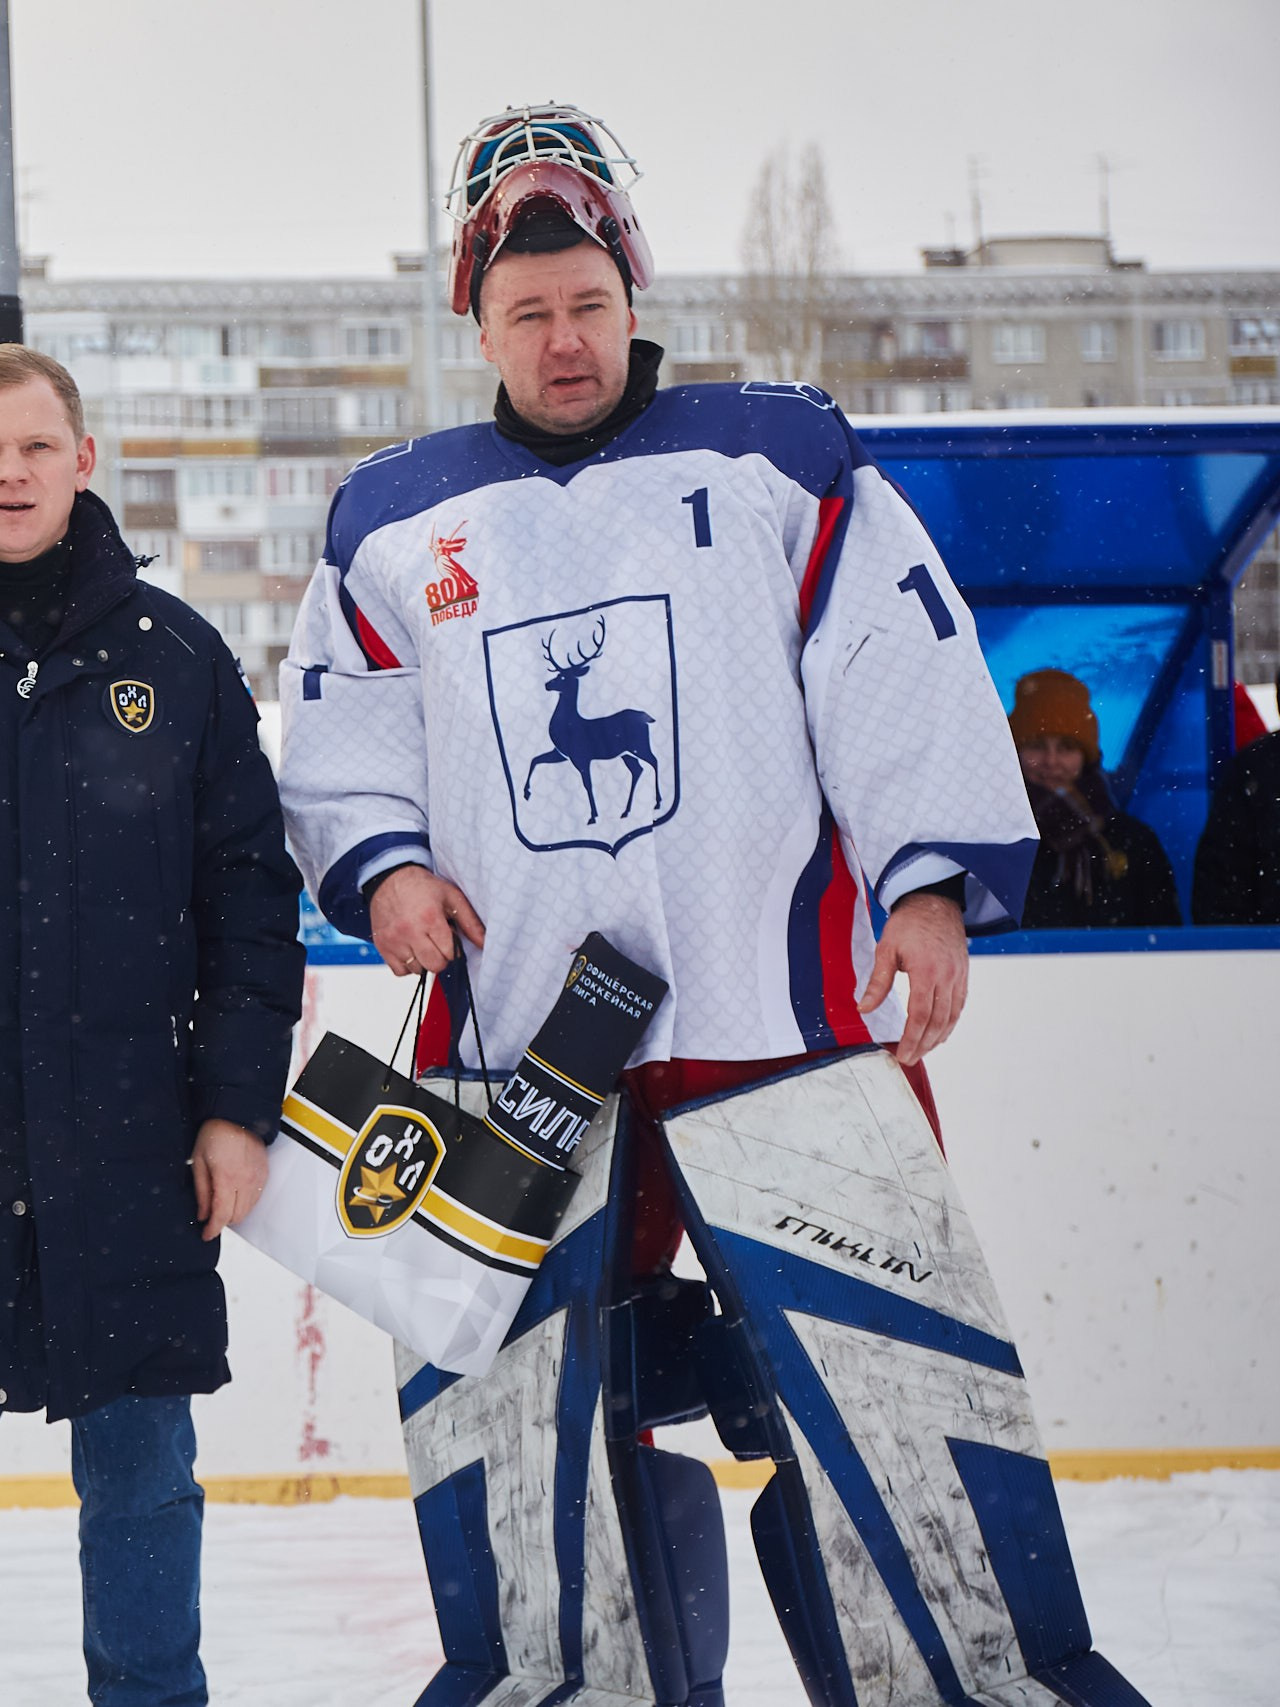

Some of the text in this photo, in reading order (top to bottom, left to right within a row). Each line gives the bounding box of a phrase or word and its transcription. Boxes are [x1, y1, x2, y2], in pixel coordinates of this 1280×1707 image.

[681, 487, 712, 547] 1
[425, 577, 455, 608] 80
[897, 563, 957, 641] 1
[572, 984, 597, 1006] ЛИГА
[579, 974, 642, 1019] ХОККЕЙНАЯ
[586, 962, 654, 1011] ОФИЦЕРСКАЯ
